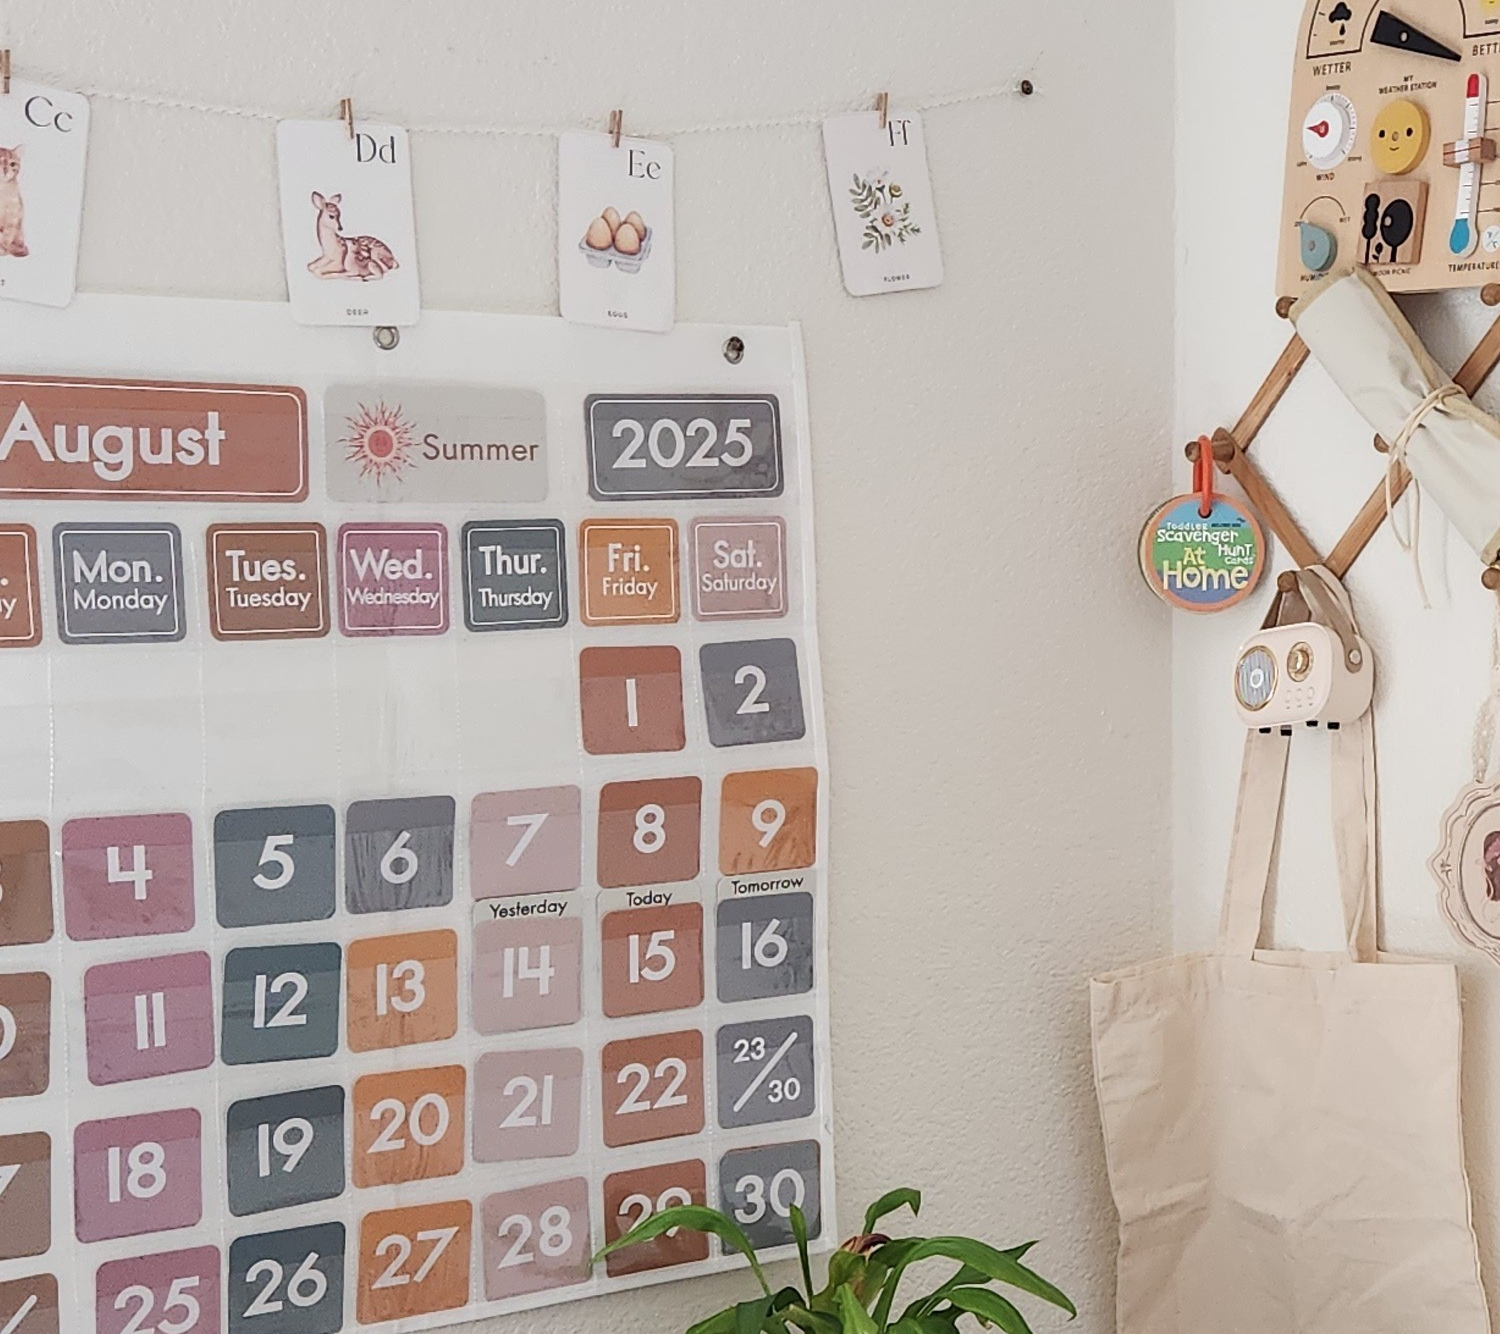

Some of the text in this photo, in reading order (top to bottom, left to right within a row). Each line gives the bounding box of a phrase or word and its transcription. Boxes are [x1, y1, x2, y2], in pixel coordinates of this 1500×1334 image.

[1313, 62, 1351, 76] WETTER
[25, 96, 73, 133] Cc
[356, 133, 396, 163] Dd
[628, 149, 661, 180] Ee
[1449, 261, 1499, 273] TEMPERATURE
[0, 400, 227, 481] August
[422, 434, 541, 467] Summer
[610, 417, 755, 472] 2025
[479, 545, 547, 577] Thur.
[608, 543, 650, 573] Fri.
[713, 539, 762, 569] Sat.
[1157, 529, 1238, 545] Scavenger
[1183, 547, 1206, 565] At
[72, 549, 163, 584] Mon.
[225, 549, 306, 582] Tues.
[350, 547, 433, 581] Wed.
[602, 577, 658, 600] Friday
[701, 573, 777, 595] Saturday
[1163, 560, 1248, 591] Home
[74, 588, 169, 616] Monday
[225, 588, 312, 611] Tuesday
[347, 587, 440, 610] Wednesday
[478, 588, 553, 611] Thursday
[625, 678, 638, 727] 1
[734, 665, 770, 715] 2
[505, 812, 551, 868] 7
[633, 802, 667, 856] 8
[750, 798, 788, 849] 9
[105, 843, 154, 903] 4
[252, 832, 297, 892] 5
[380, 830, 419, 886] 6
[489, 900, 568, 919] Yesterday
[626, 890, 673, 907] Today
[731, 876, 804, 895] Tomorrow
[628, 929, 676, 984] 15
[741, 918, 788, 970] 16
[373, 959, 427, 1016] 13
[502, 944, 555, 999] 14
[132, 990, 167, 1052] 11
[251, 971, 310, 1031] 12
[498, 1073, 555, 1130] 21
[614, 1055, 688, 1117] 22
[255, 1116, 315, 1178] 19
[367, 1091, 451, 1156] 20
[105, 1140, 169, 1205] 18
[734, 1168, 805, 1224] 30
[373, 1226, 463, 1292] 27
[496, 1205, 574, 1268] 28
[241, 1253, 328, 1320] 26
